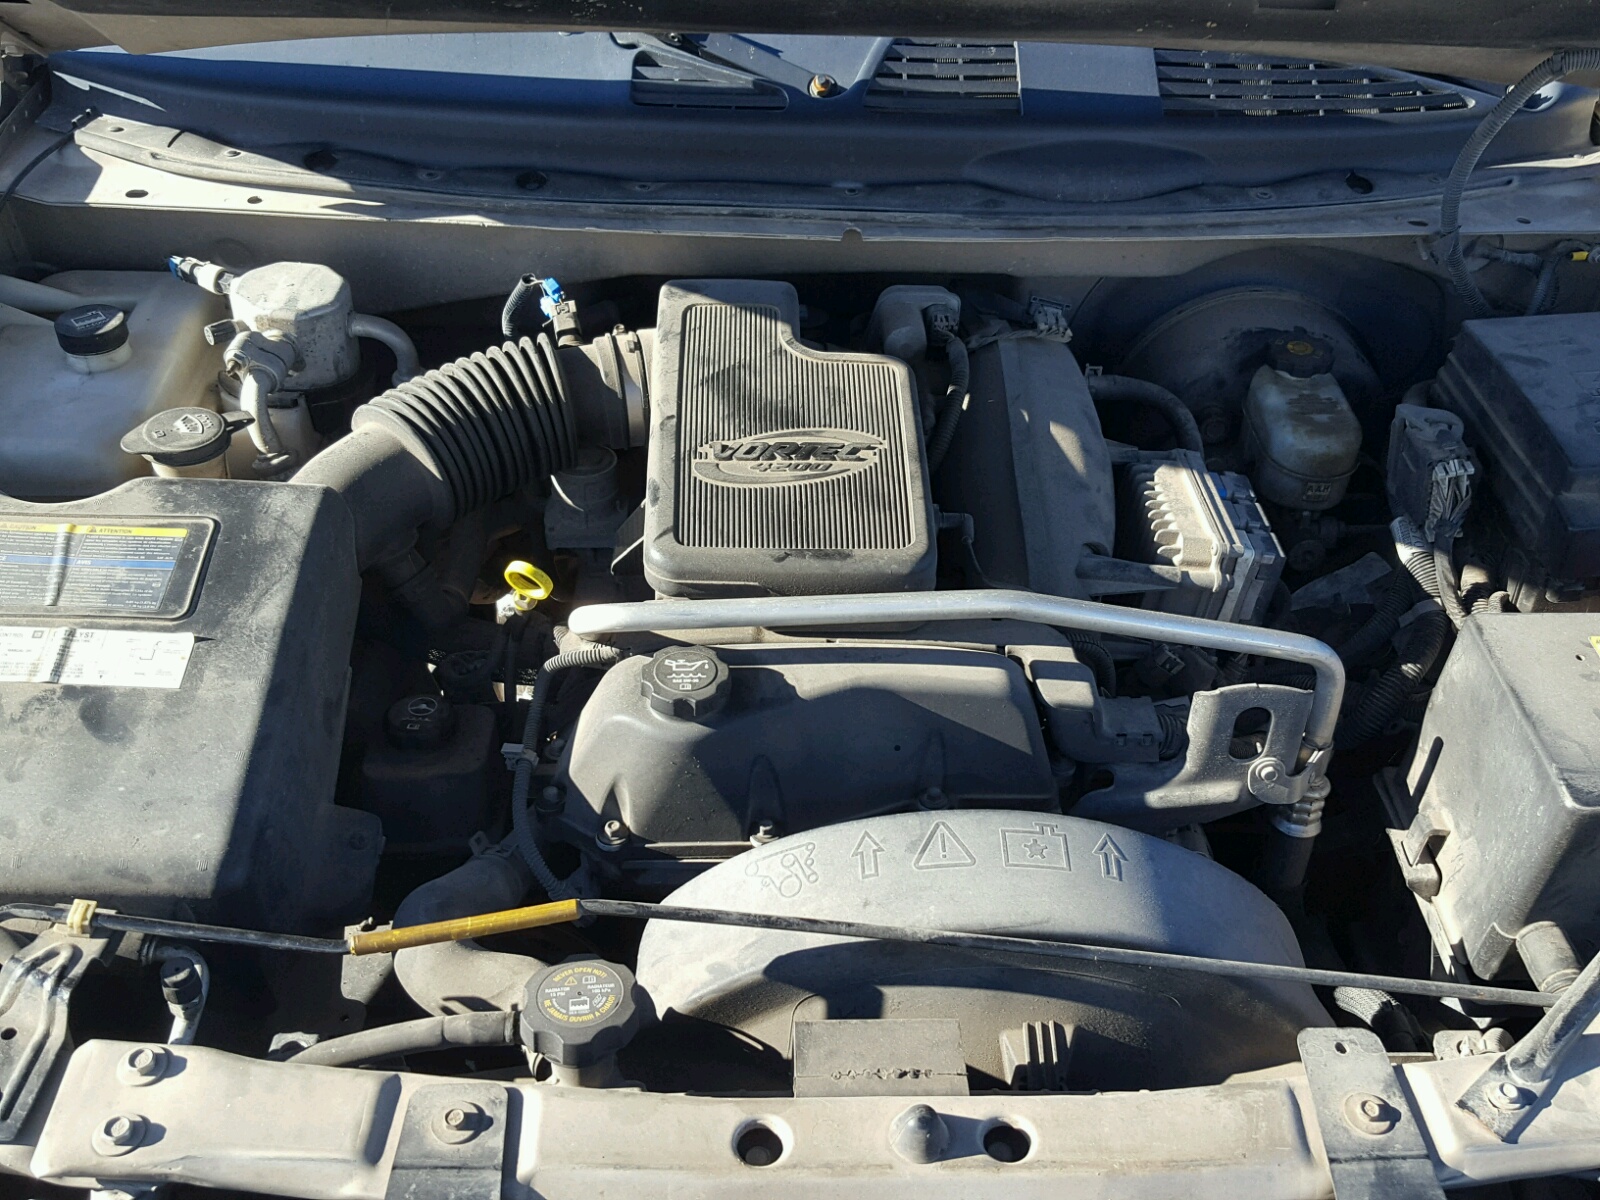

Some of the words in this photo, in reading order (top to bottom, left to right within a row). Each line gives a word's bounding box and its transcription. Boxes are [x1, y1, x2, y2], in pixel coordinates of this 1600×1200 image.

[709, 441, 879, 462] VORTEC
[750, 462, 833, 473] 4200
[553, 969, 573, 982] NEVER
[593, 969, 607, 978] HOT!
[544, 999, 551, 1007] NE
[547, 1006, 568, 1021] JAMAIS
[569, 1014, 594, 1022] OUVRIR
